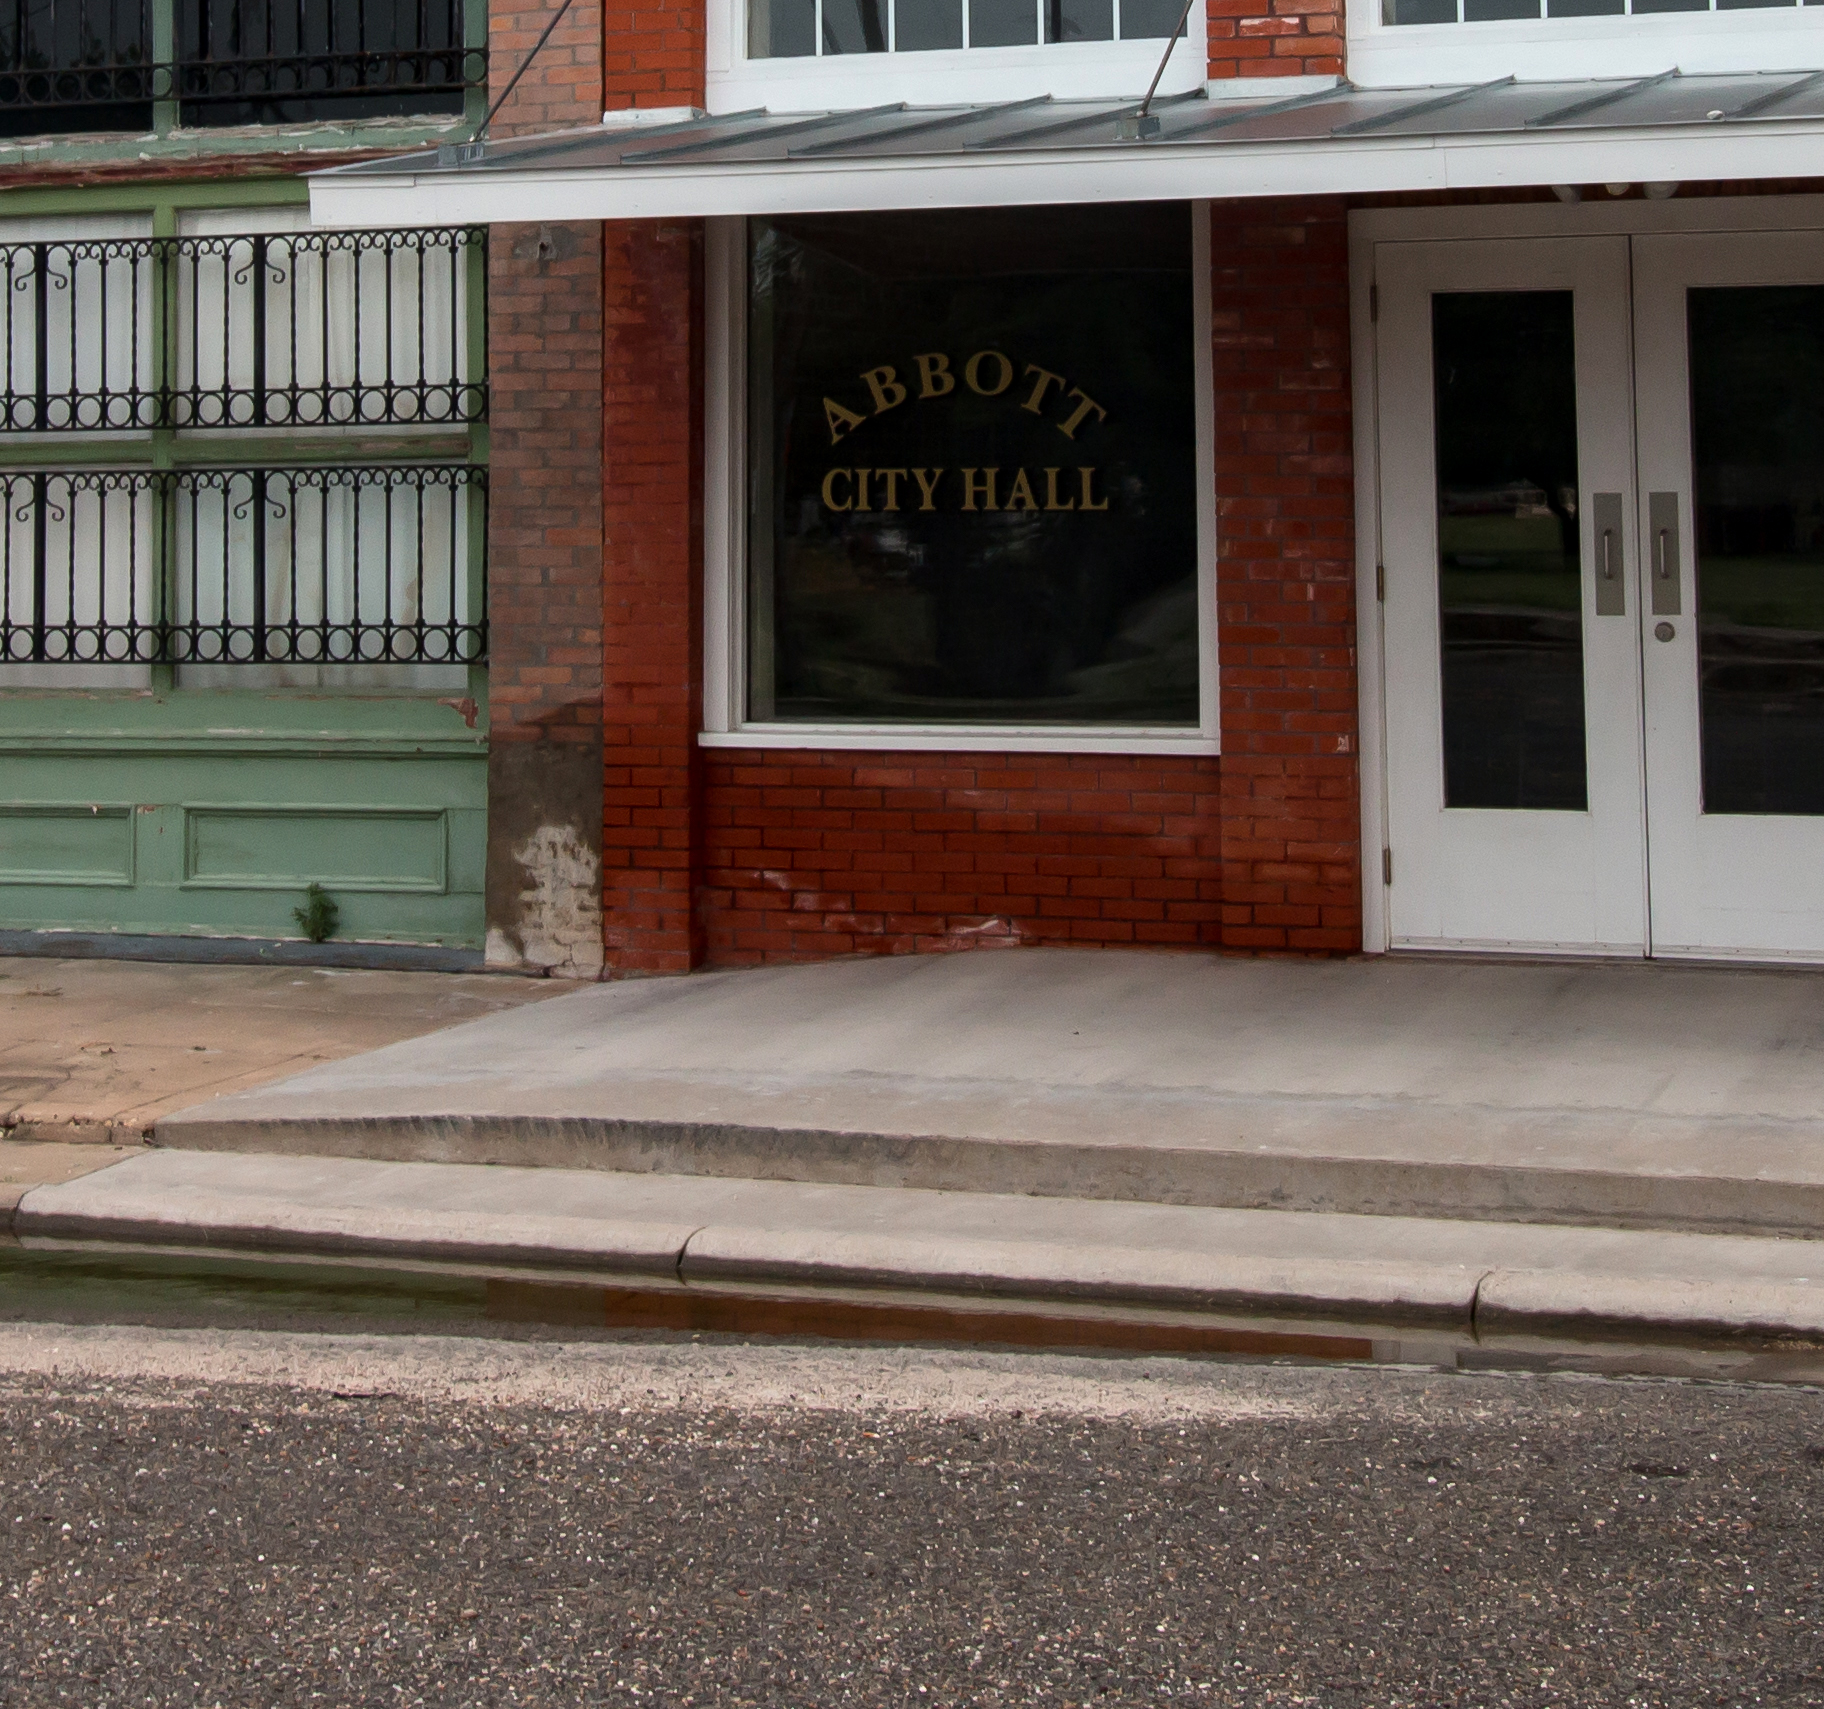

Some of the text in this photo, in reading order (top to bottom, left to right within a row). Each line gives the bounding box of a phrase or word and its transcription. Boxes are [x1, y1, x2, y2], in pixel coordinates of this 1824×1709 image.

[821, 349, 1108, 446] ABBOTT
[821, 466, 1109, 512] CITY HALL
